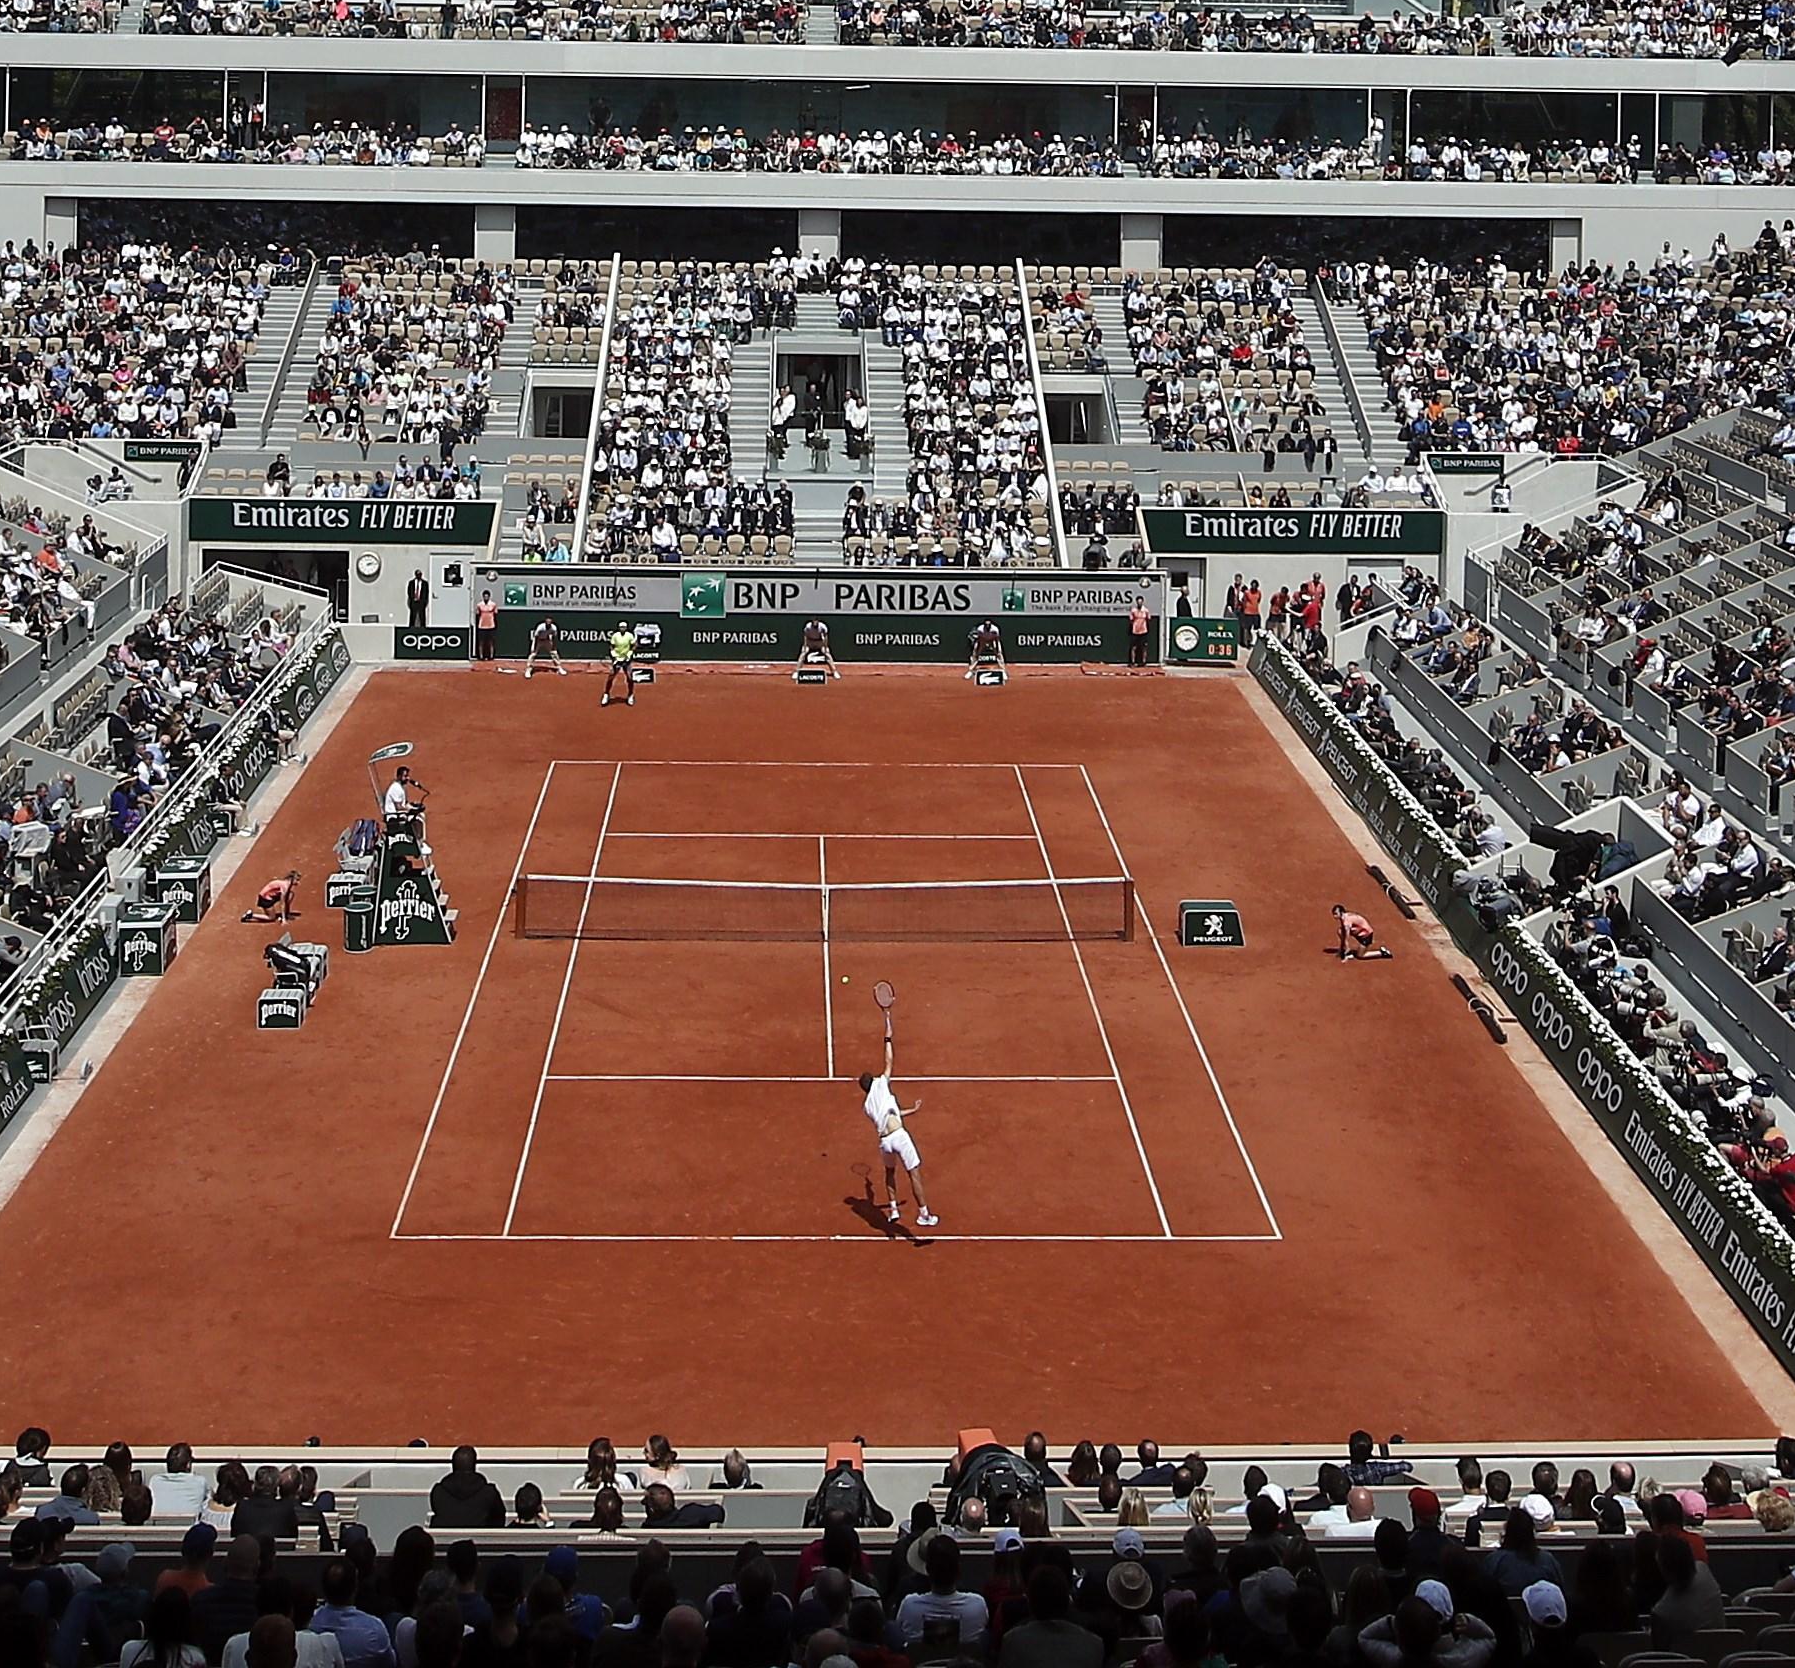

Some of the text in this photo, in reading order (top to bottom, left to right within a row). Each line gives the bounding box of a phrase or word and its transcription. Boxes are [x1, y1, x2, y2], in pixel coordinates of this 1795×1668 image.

[139, 447, 159, 455] BNP
[1443, 459, 1501, 468] BNP PARIBAS
[232, 501, 456, 530] Emirates FLY BETTER
[1184, 512, 1403, 539] Emirates FLY BETTER
[532, 584, 637, 600] BNP PARIBAS
[733, 582, 971, 611] BNP PARIBAS
[1030, 589, 1134, 605] BNP PARIBAS
[402, 633, 462, 650] oppo
[559, 630, 614, 643] PARIBAS
[692, 631, 778, 645] BNP PARIBAS
[855, 633, 940, 646] BNP PARIBAS
[1018, 634, 1102, 647] BNP PARIBAS
[1207, 631, 1234, 639] ROLEX
[1207, 643, 1233, 656] 0:36
[1292, 697, 1321, 738] PEUGEOT
[244, 740, 267, 779] oppo
[1325, 739, 1358, 785] PEUGEOT
[329, 883, 352, 906] perri
[379, 894, 436, 934] perrier
[1193, 935, 1234, 943] PEUGEOT
[1491, 942, 1528, 996] oppo
[260, 1000, 297, 1027] perrier
[1532, 991, 1573, 1050] oppo
[1577, 1047, 1623, 1112] oppo
[0, 1076, 29, 1119] ROLEX
[1623, 1109, 1677, 1191] Emirates
[1672, 1172, 1696, 1212] FLY
[1686, 1191, 1725, 1250] BETTER
[1720, 1229, 1786, 1329] Emirates
